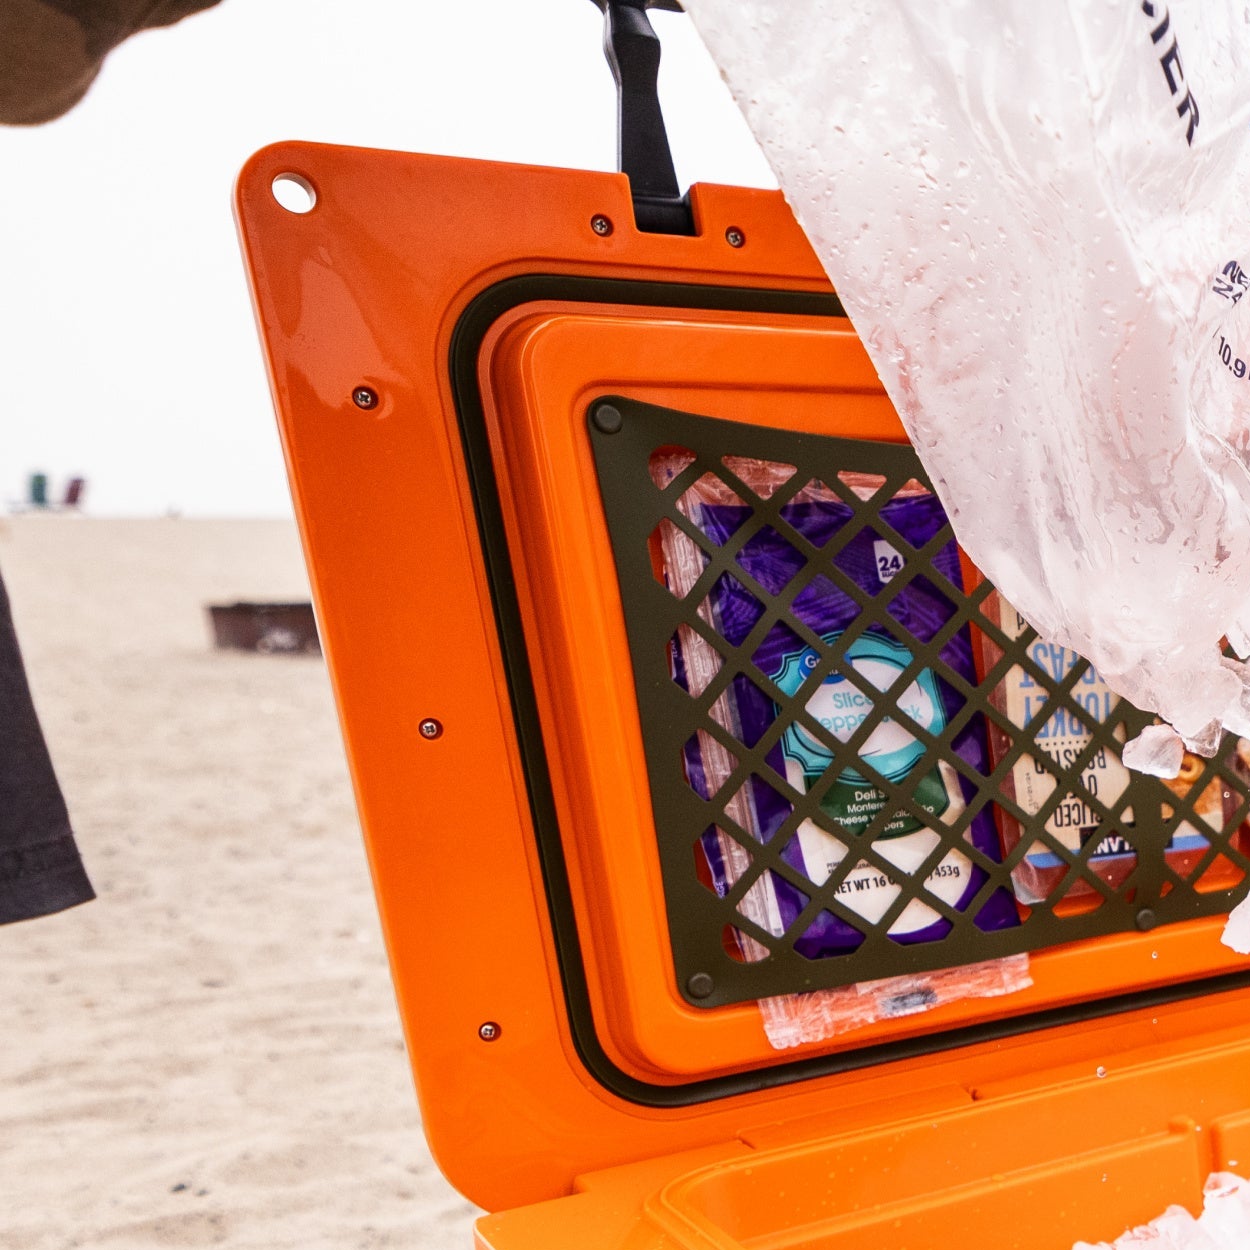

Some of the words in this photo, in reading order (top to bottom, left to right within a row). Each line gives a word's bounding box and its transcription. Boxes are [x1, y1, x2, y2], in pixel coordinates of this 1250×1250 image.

[1141, 0, 1200, 147] IER
[878, 555, 901, 571] 24
[1019, 643, 1106, 688] RAST
[832, 689, 886, 709] Slic
[817, 713, 868, 732] eppe
[854, 789, 876, 801] Deli
[847, 802, 888, 813] Montere
[853, 878, 871, 891] WT
[872, 876, 887, 888] 16
[934, 864, 961, 879] 453g
